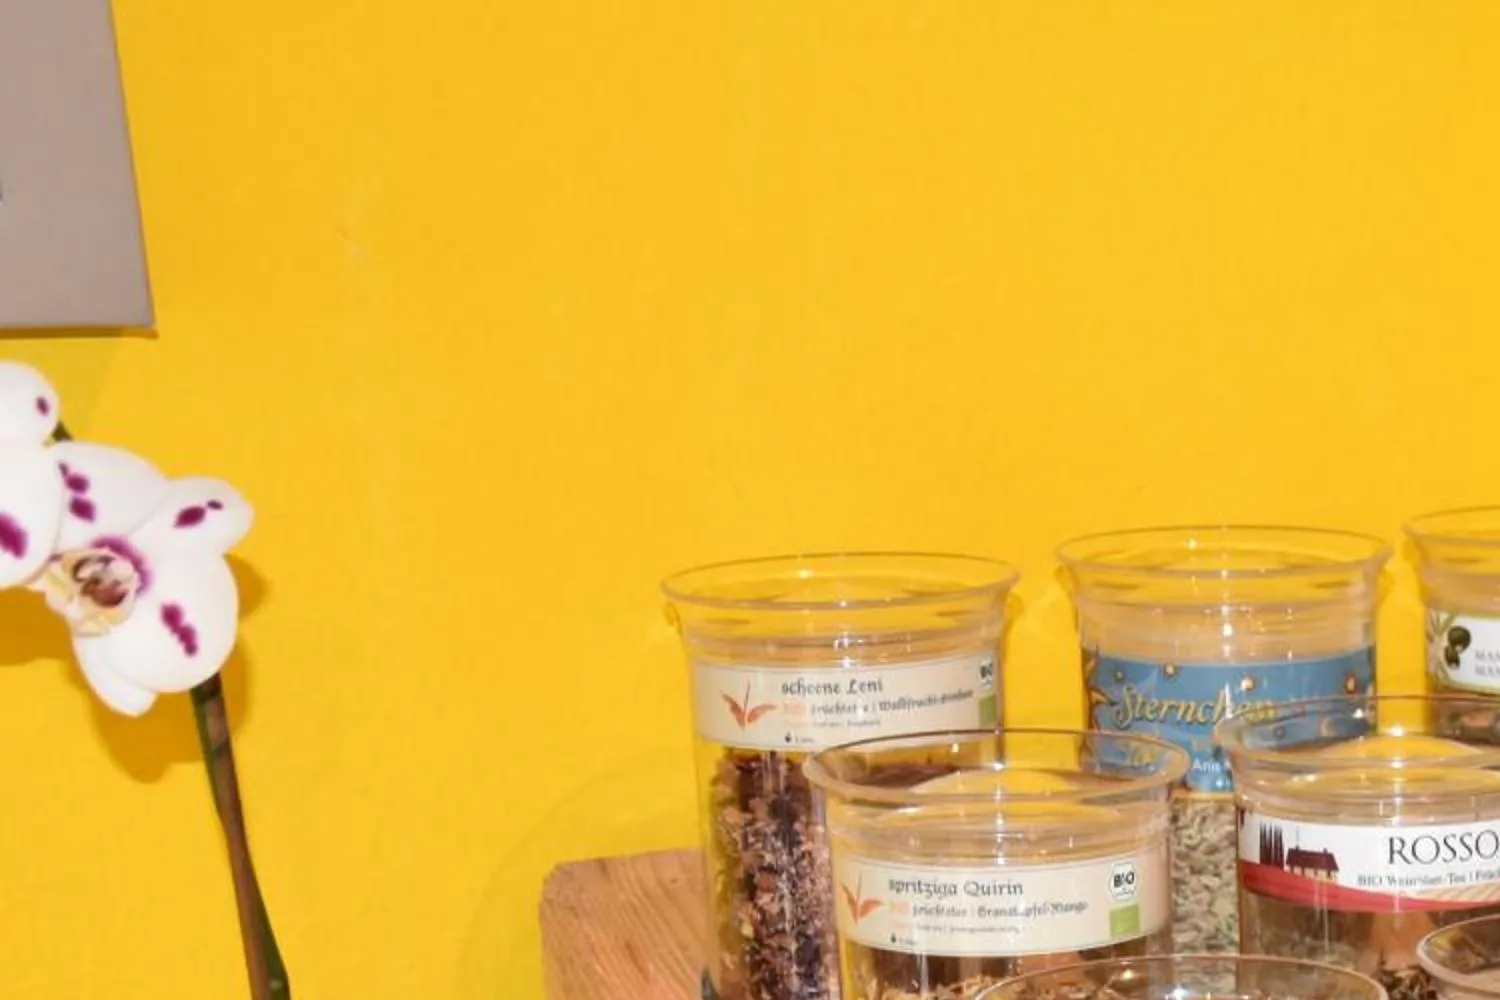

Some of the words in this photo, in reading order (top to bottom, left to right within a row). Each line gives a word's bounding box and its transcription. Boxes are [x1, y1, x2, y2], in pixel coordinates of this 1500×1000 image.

[846, 677, 883, 695] Leni
[1388, 829, 1499, 865] ROSSO
[963, 879, 1023, 897] Quirin
[1113, 871, 1135, 889] BIO
